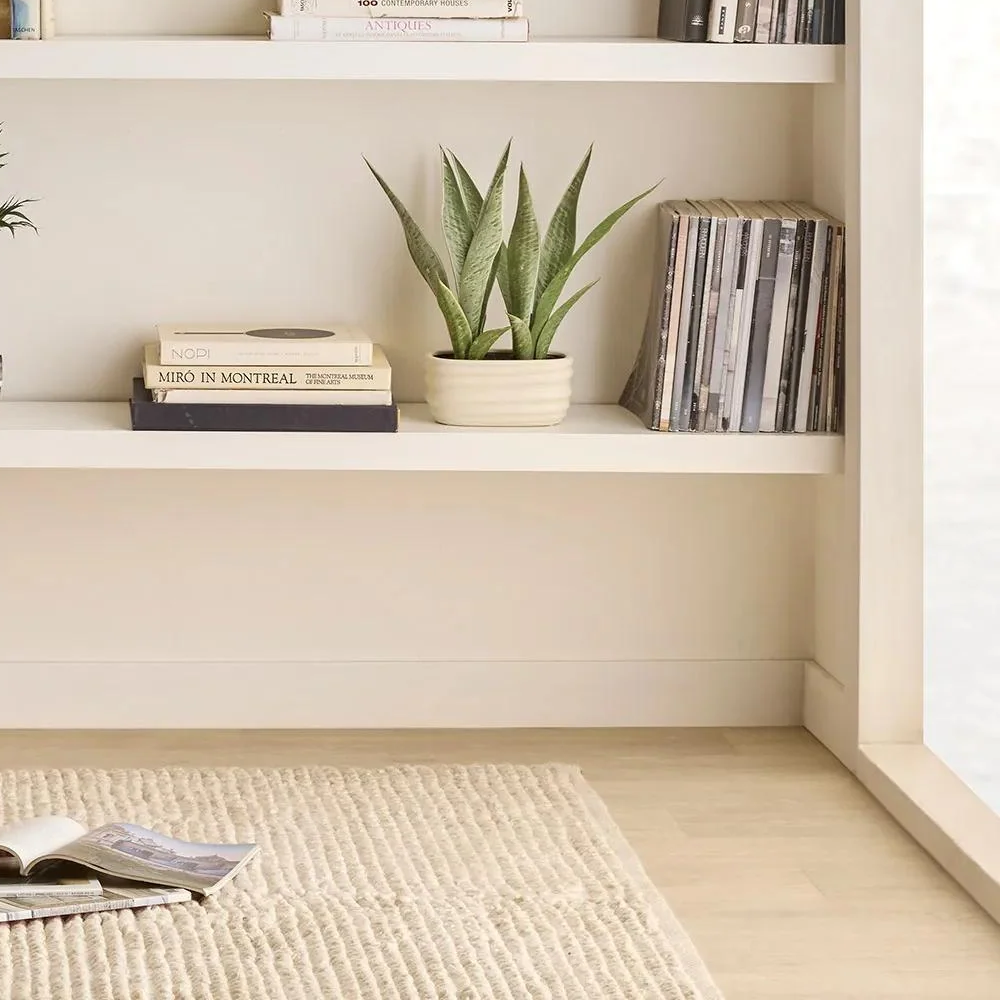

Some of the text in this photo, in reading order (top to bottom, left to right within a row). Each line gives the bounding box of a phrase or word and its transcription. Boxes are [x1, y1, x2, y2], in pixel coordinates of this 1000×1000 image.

[365, 20, 432, 33] ANTIQUES
[158, 369, 298, 385] MIRÓ IN MONTREAL
